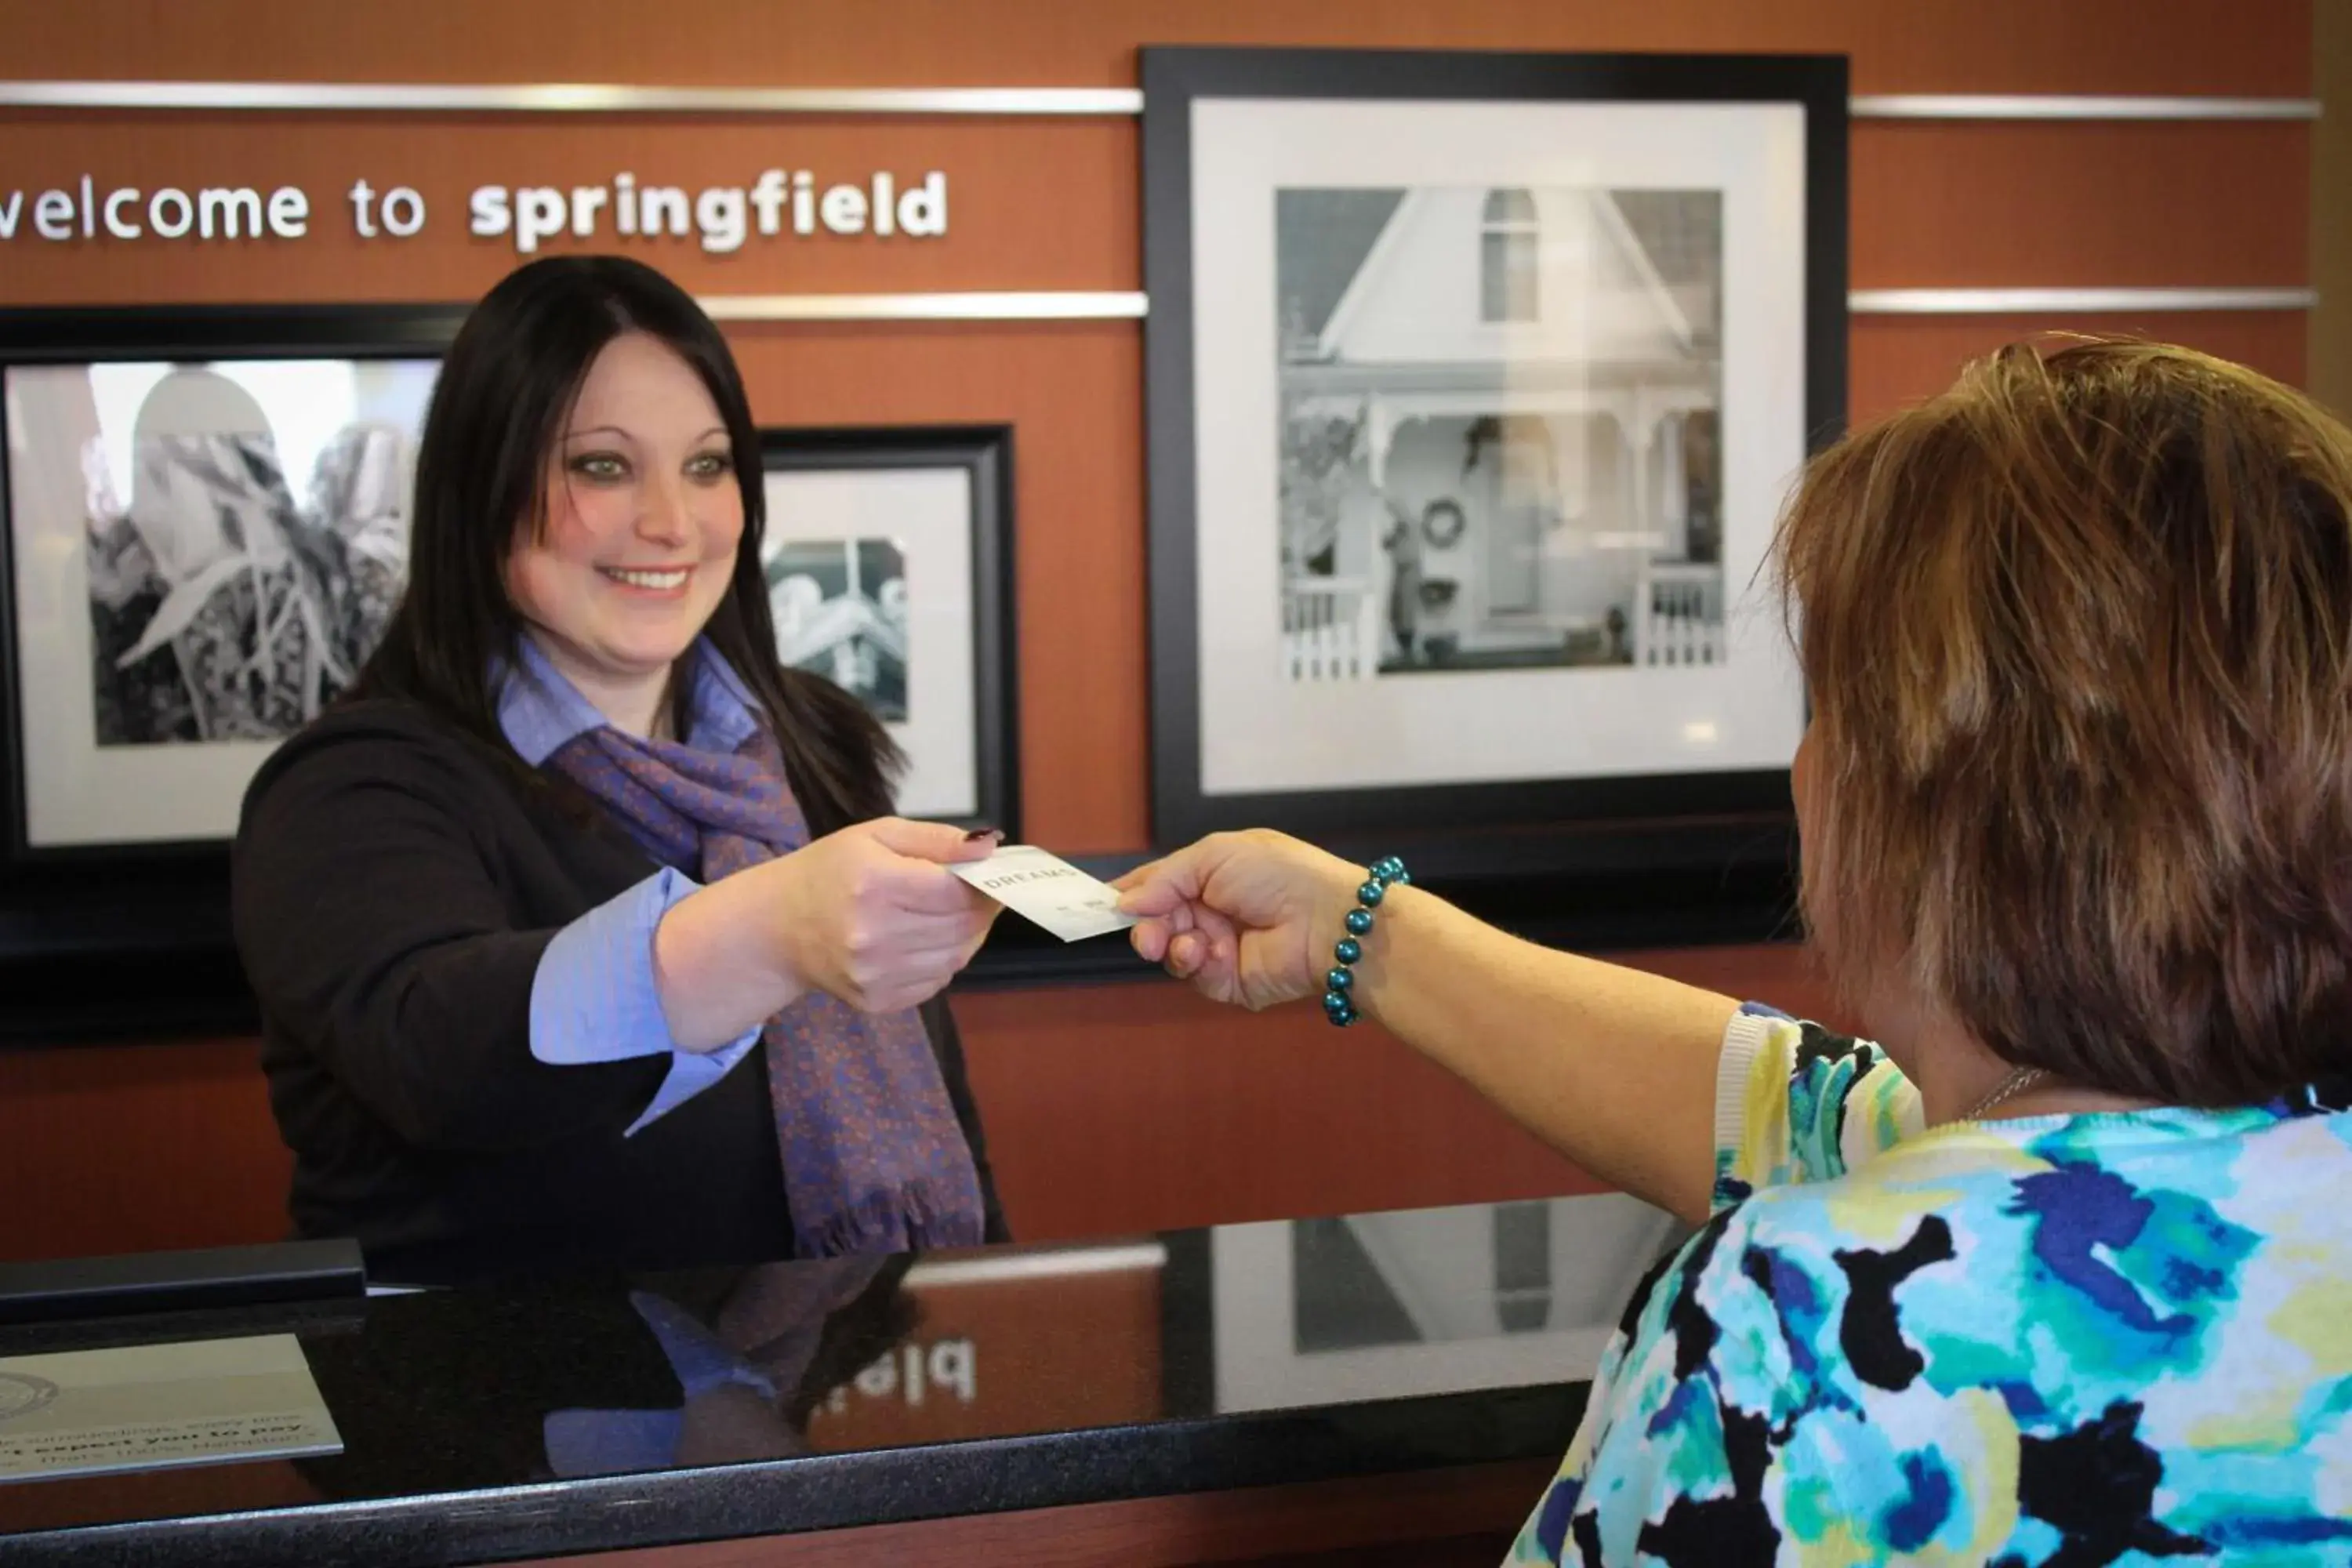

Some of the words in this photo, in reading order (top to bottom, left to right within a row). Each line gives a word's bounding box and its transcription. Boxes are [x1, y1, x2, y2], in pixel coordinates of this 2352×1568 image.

[348, 179, 426, 238] to
[470, 169, 946, 252] springfield
[984, 867, 1079, 890] DREAMS
[34, 1439, 132, 1454] expect
[146, 1434, 199, 1445] you
[209, 1428, 240, 1438] to
